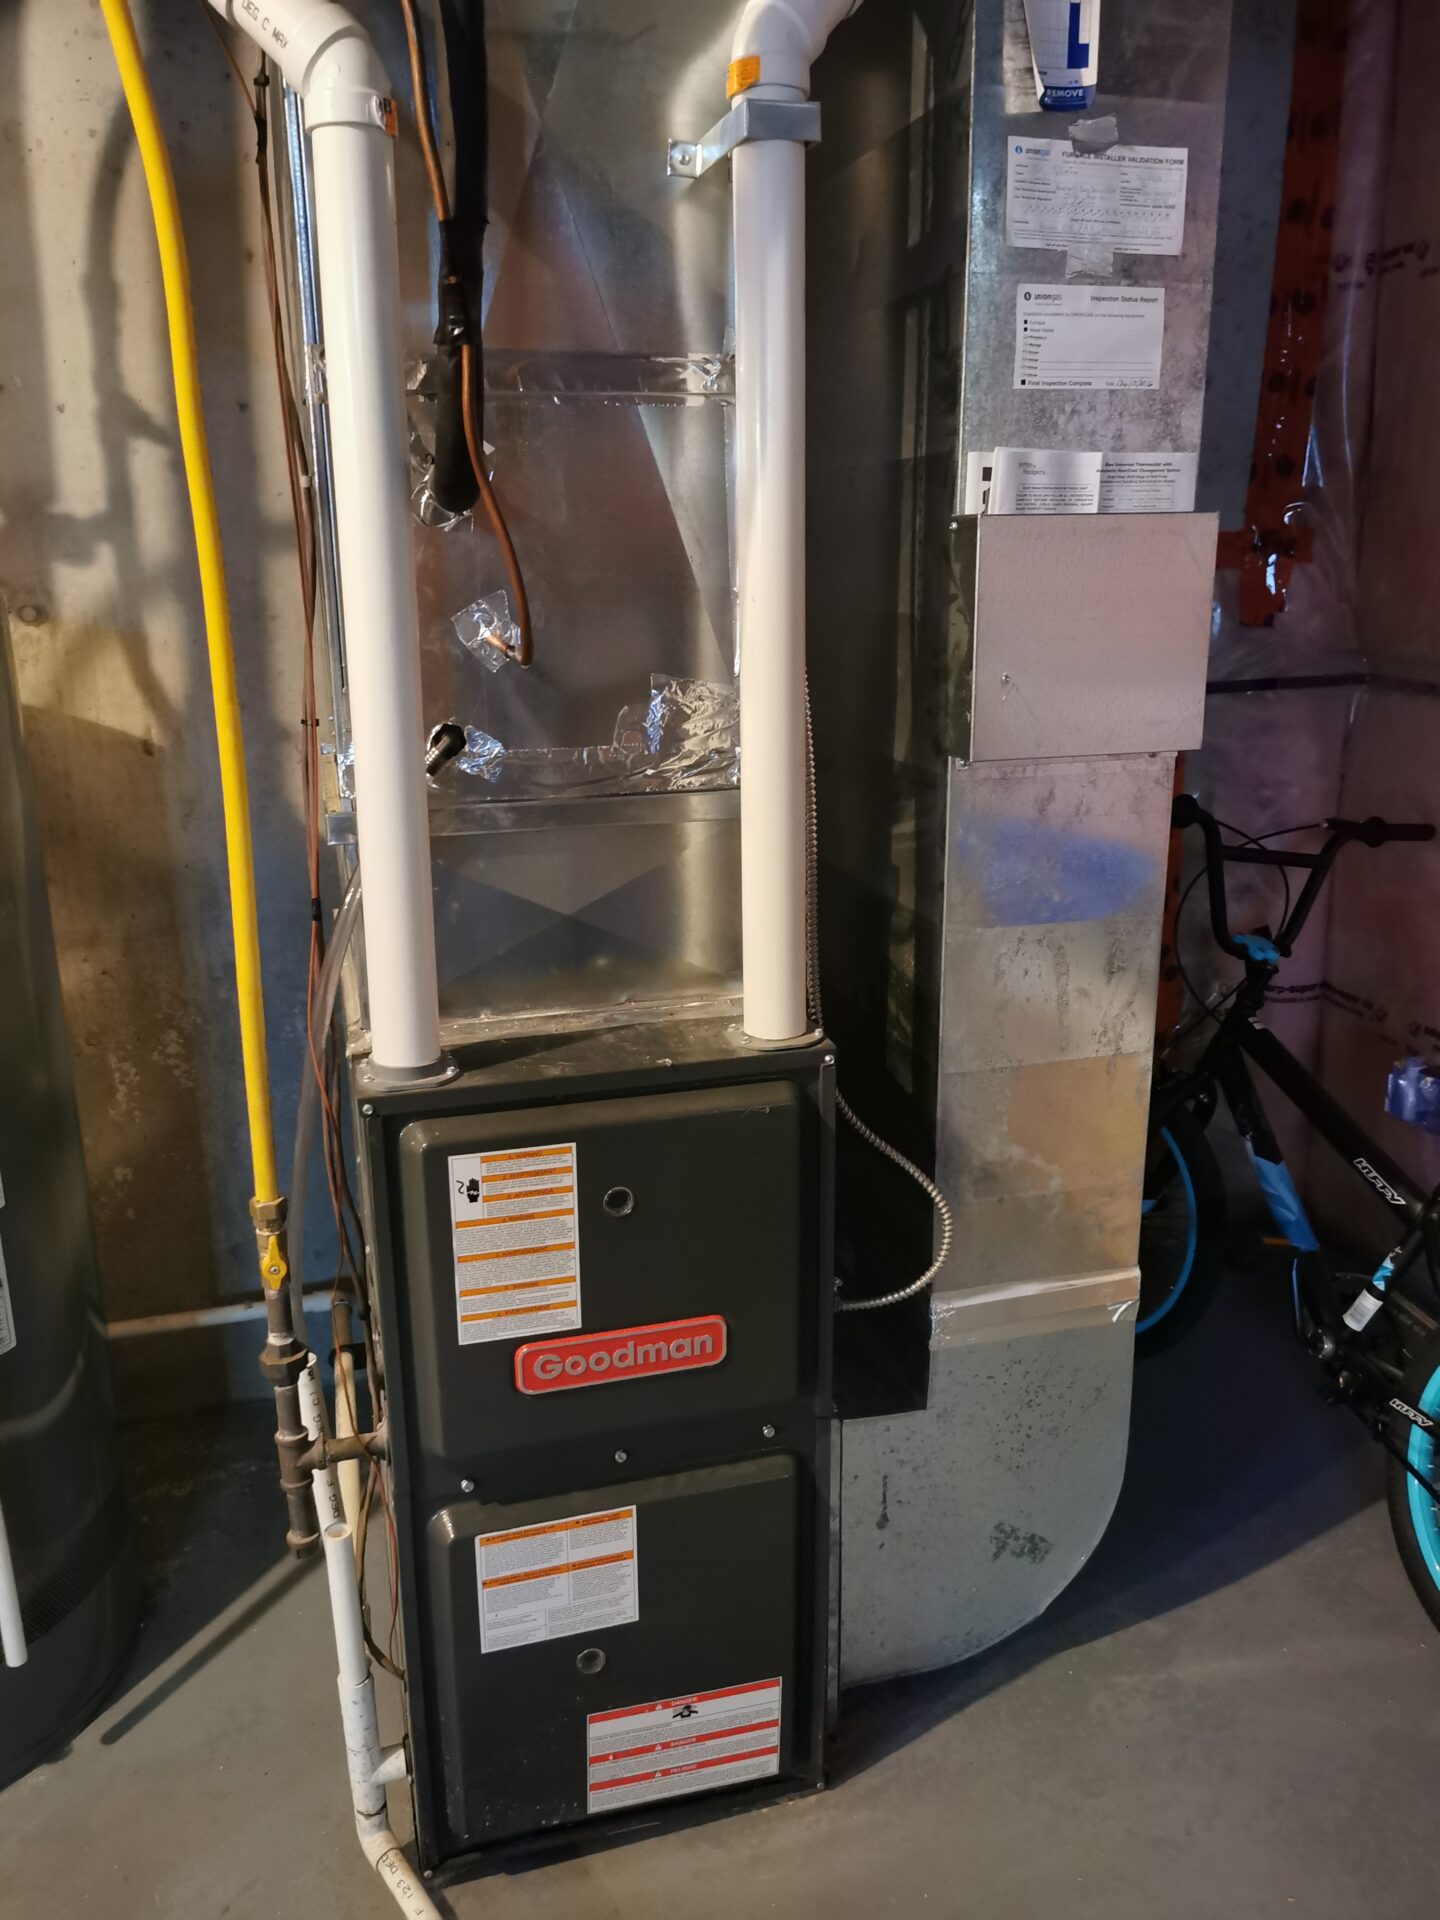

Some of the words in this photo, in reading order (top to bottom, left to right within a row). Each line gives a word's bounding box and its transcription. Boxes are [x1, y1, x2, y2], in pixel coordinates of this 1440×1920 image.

[262, 16, 270, 32] C
[1045, 88, 1084, 98] REMOVE
[1127, 155, 1164, 165] VALIDATION
[1165, 158, 1185, 166] FORM
[1090, 295, 1120, 303] Inspection
[1139, 296, 1159, 304] Report
[1353, 1157, 1406, 1205] HUFFY
[533, 1333, 714, 1380] Goodman
[1388, 1397, 1434, 1427] HUFFY
[328, 1494, 340, 1518] DEG
[671, 1697, 697, 1706] DANGER
[670, 1738, 697, 1747] DANGER
